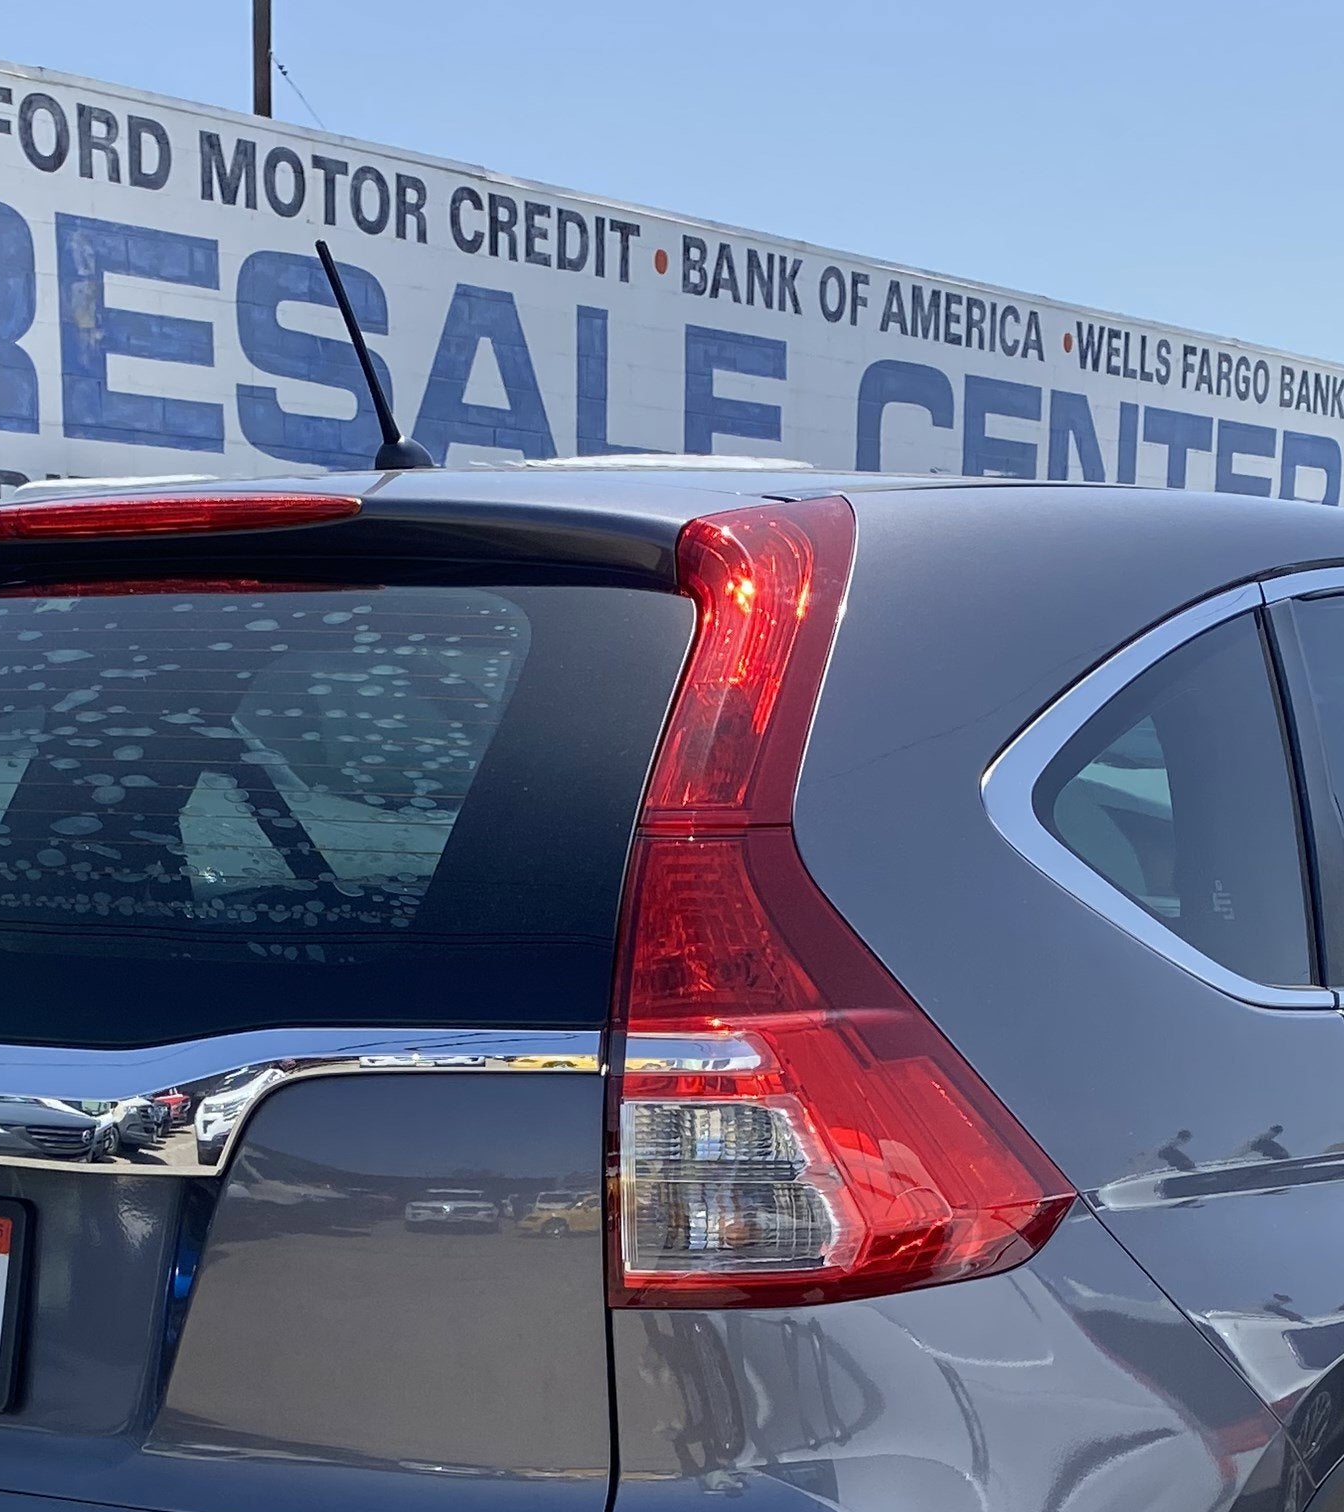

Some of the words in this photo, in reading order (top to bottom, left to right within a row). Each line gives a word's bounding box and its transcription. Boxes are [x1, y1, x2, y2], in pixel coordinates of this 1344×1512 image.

[199, 130, 428, 244] MOTOR
[449, 186, 641, 283] CREDIT
[681, 233, 803, 315] BANK
[819, 265, 871, 326] OF
[879, 279, 1045, 362] AMERICA
[1075, 320, 1173, 385] WELLS
[1182, 344, 1270, 404] FARGO
[856, 358, 1343, 507] CENTER
